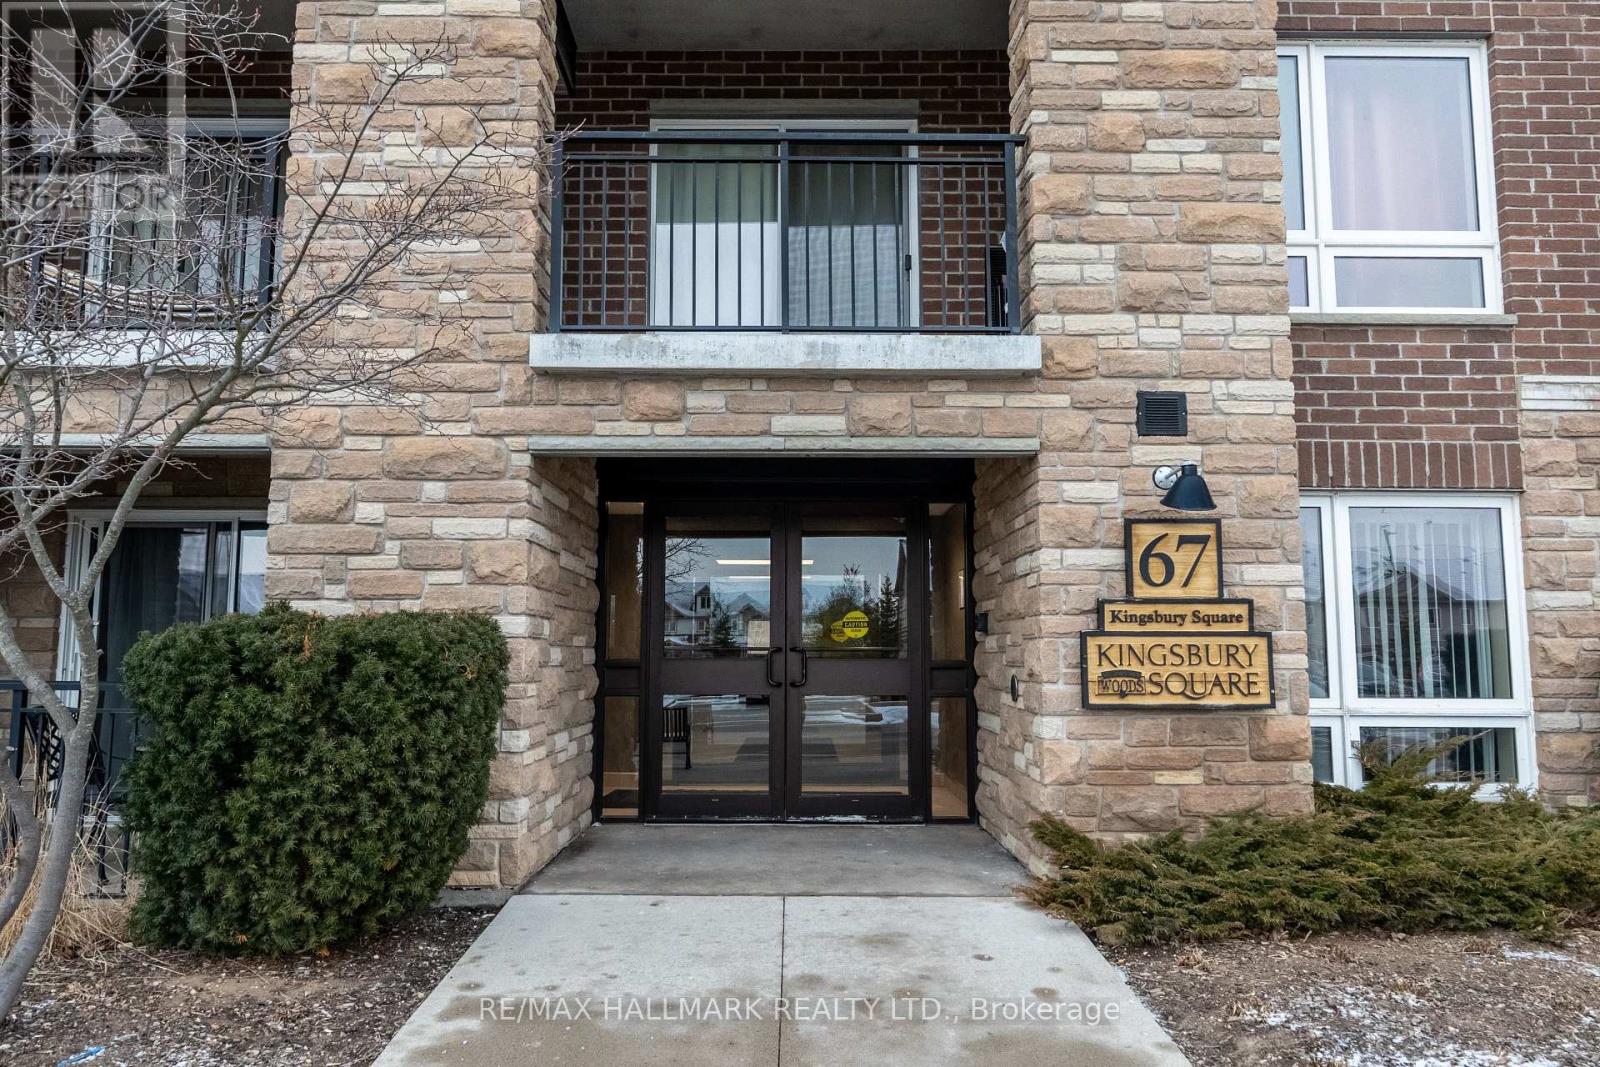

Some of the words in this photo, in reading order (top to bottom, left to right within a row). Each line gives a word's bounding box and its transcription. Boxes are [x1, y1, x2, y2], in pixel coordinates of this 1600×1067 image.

[1138, 532, 1212, 588] 67
[1110, 610, 1188, 626] Kingsbury
[1191, 610, 1244, 626] Square
[1095, 643, 1259, 668] KINGSBURY
[1099, 679, 1144, 693] WOODS
[1148, 672, 1261, 699] SQUARE
